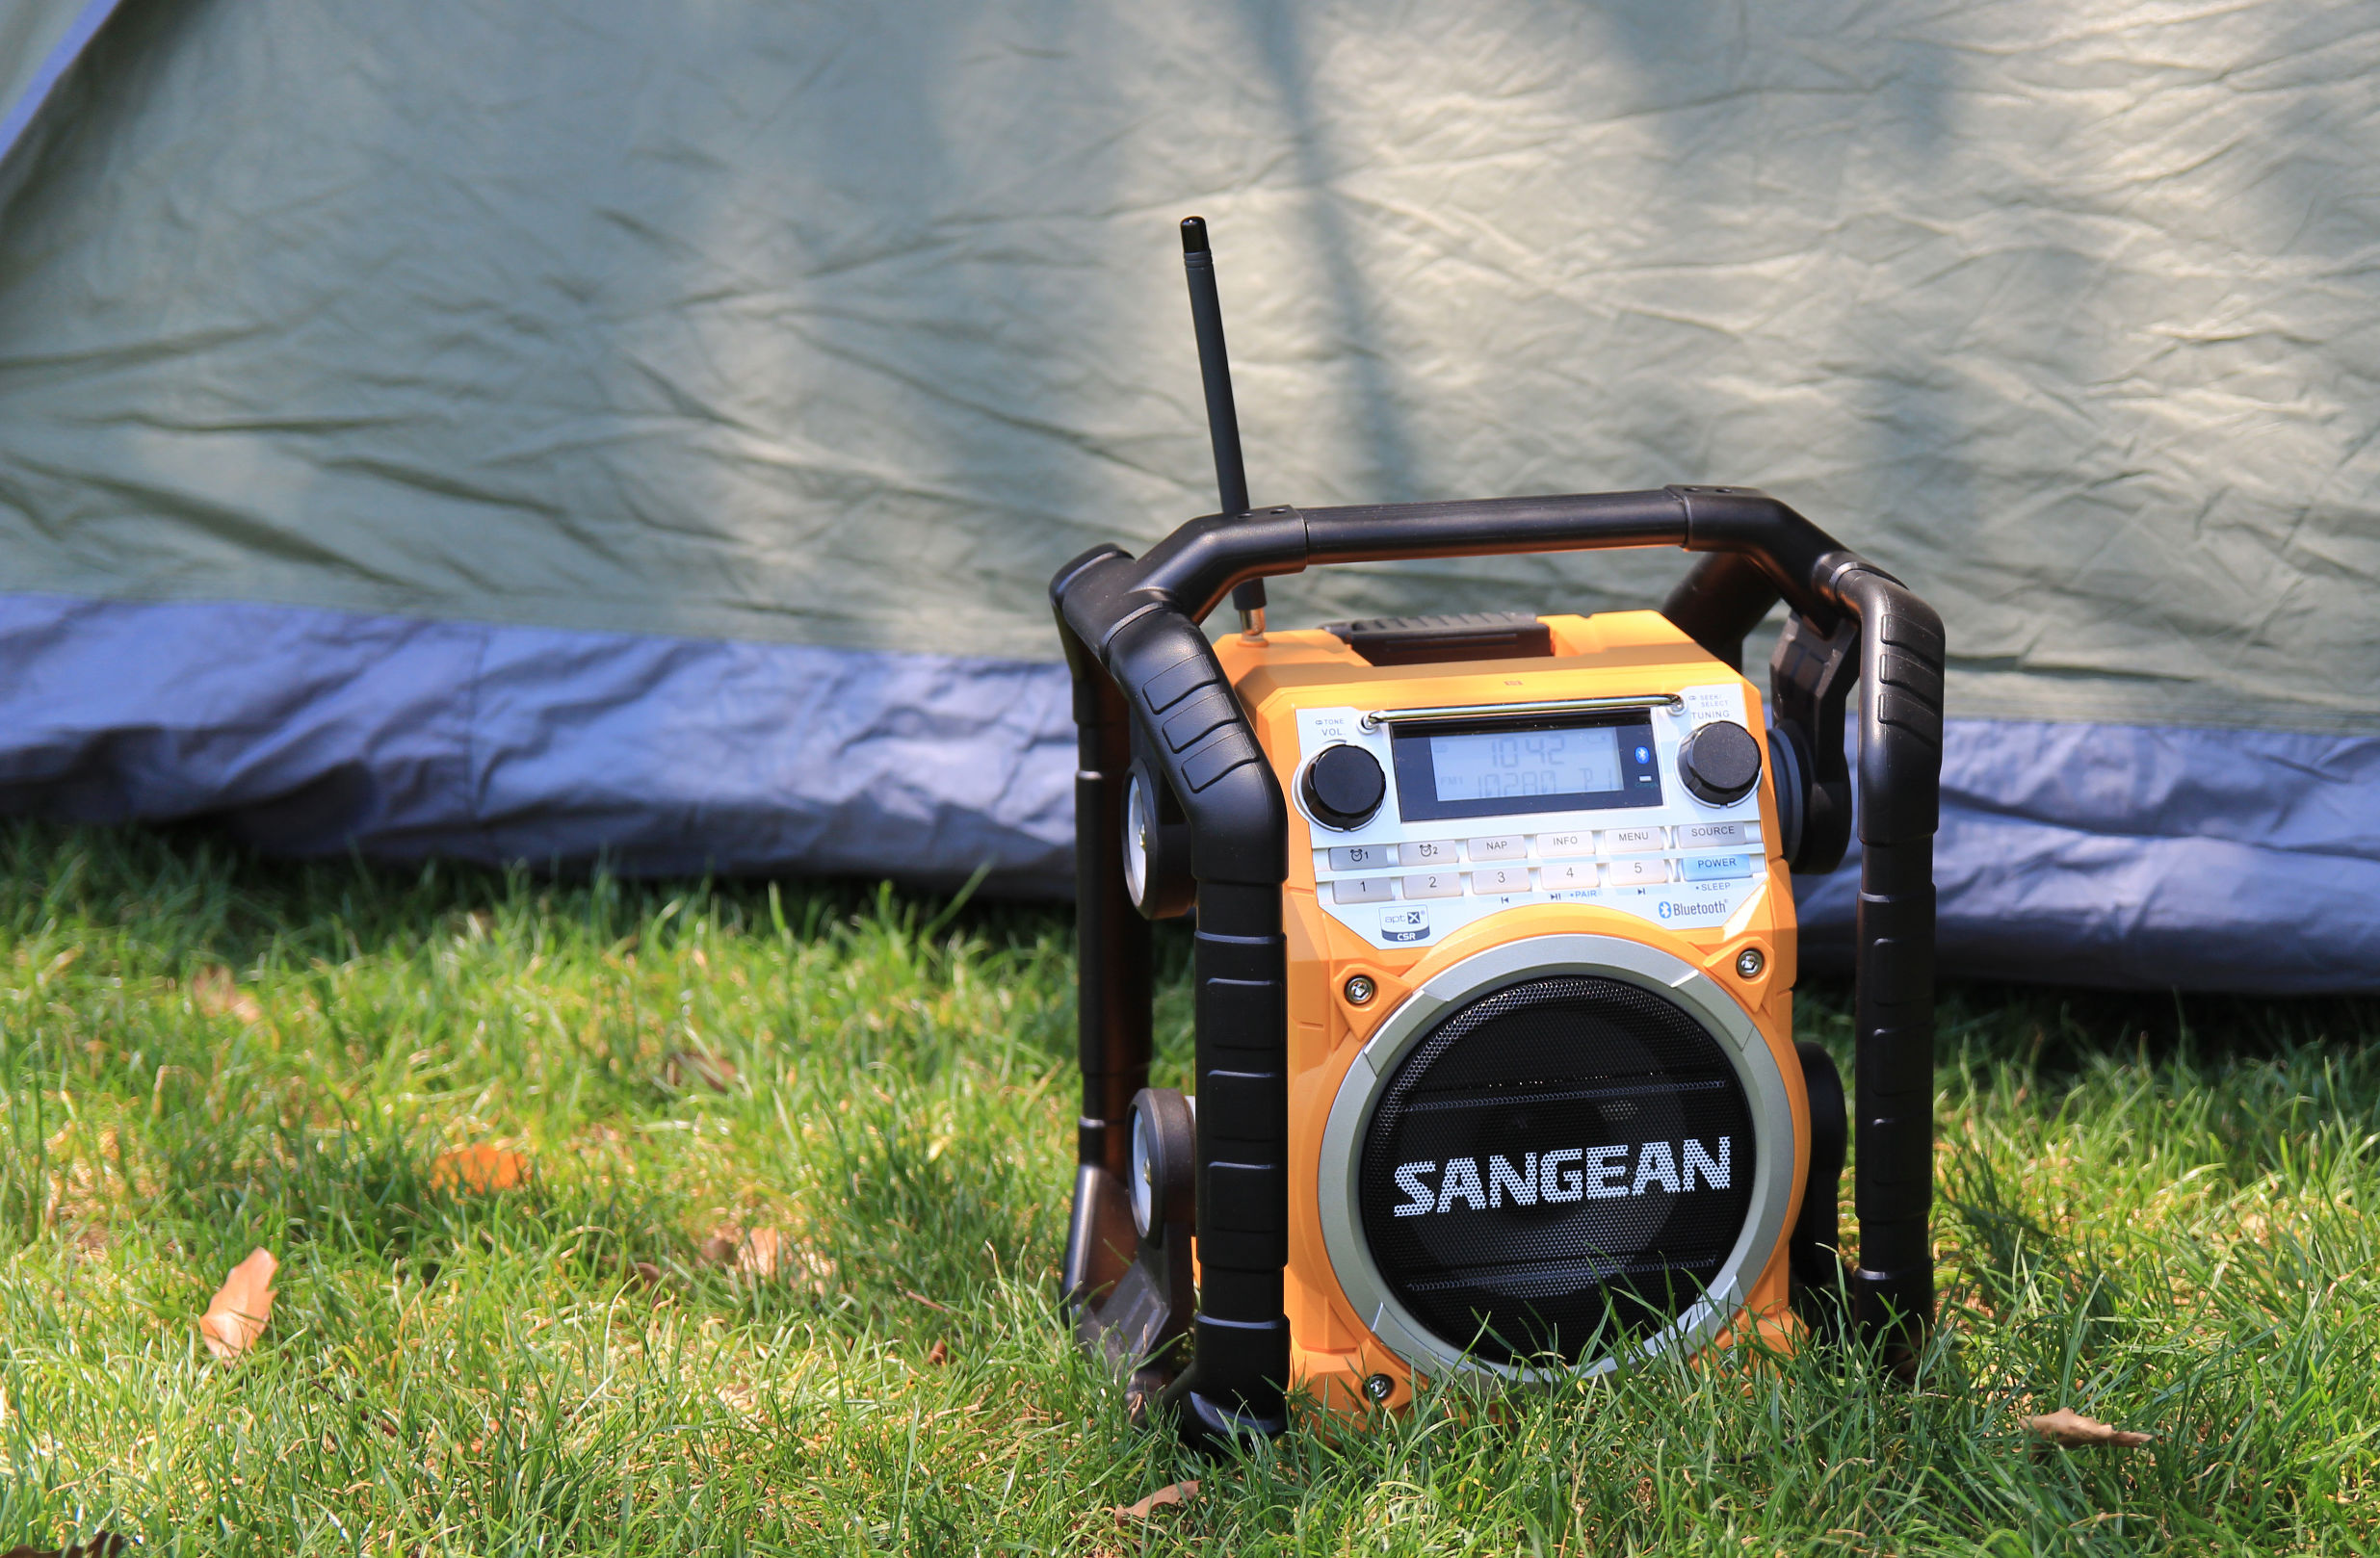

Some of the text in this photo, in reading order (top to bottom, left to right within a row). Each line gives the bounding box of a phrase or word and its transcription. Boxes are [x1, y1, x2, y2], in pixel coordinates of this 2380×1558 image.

[1692, 710, 1730, 719] TUNING
[1619, 831, 1649, 842] MENU
[1691, 825, 1736, 837] SOURCE
[1486, 841, 1508, 850] NAP
[1553, 836, 1578, 845] INFO
[1432, 846, 1439, 855] 2
[1635, 863, 1642, 874] 5
[1697, 858, 1738, 869] POWER
[1497, 871, 1506, 883] 3
[1565, 867, 1575, 878] 4
[1359, 881, 1367, 893] 1
[1428, 876, 1438, 888] 2
[1701, 882, 1732, 892] SLEEP
[1575, 890, 1598, 898] PAIR
[1673, 900, 1727, 917] Bluetooth
[1397, 932, 1417, 942] CSR
[1394, 1135, 1731, 1217] SANGEAN
